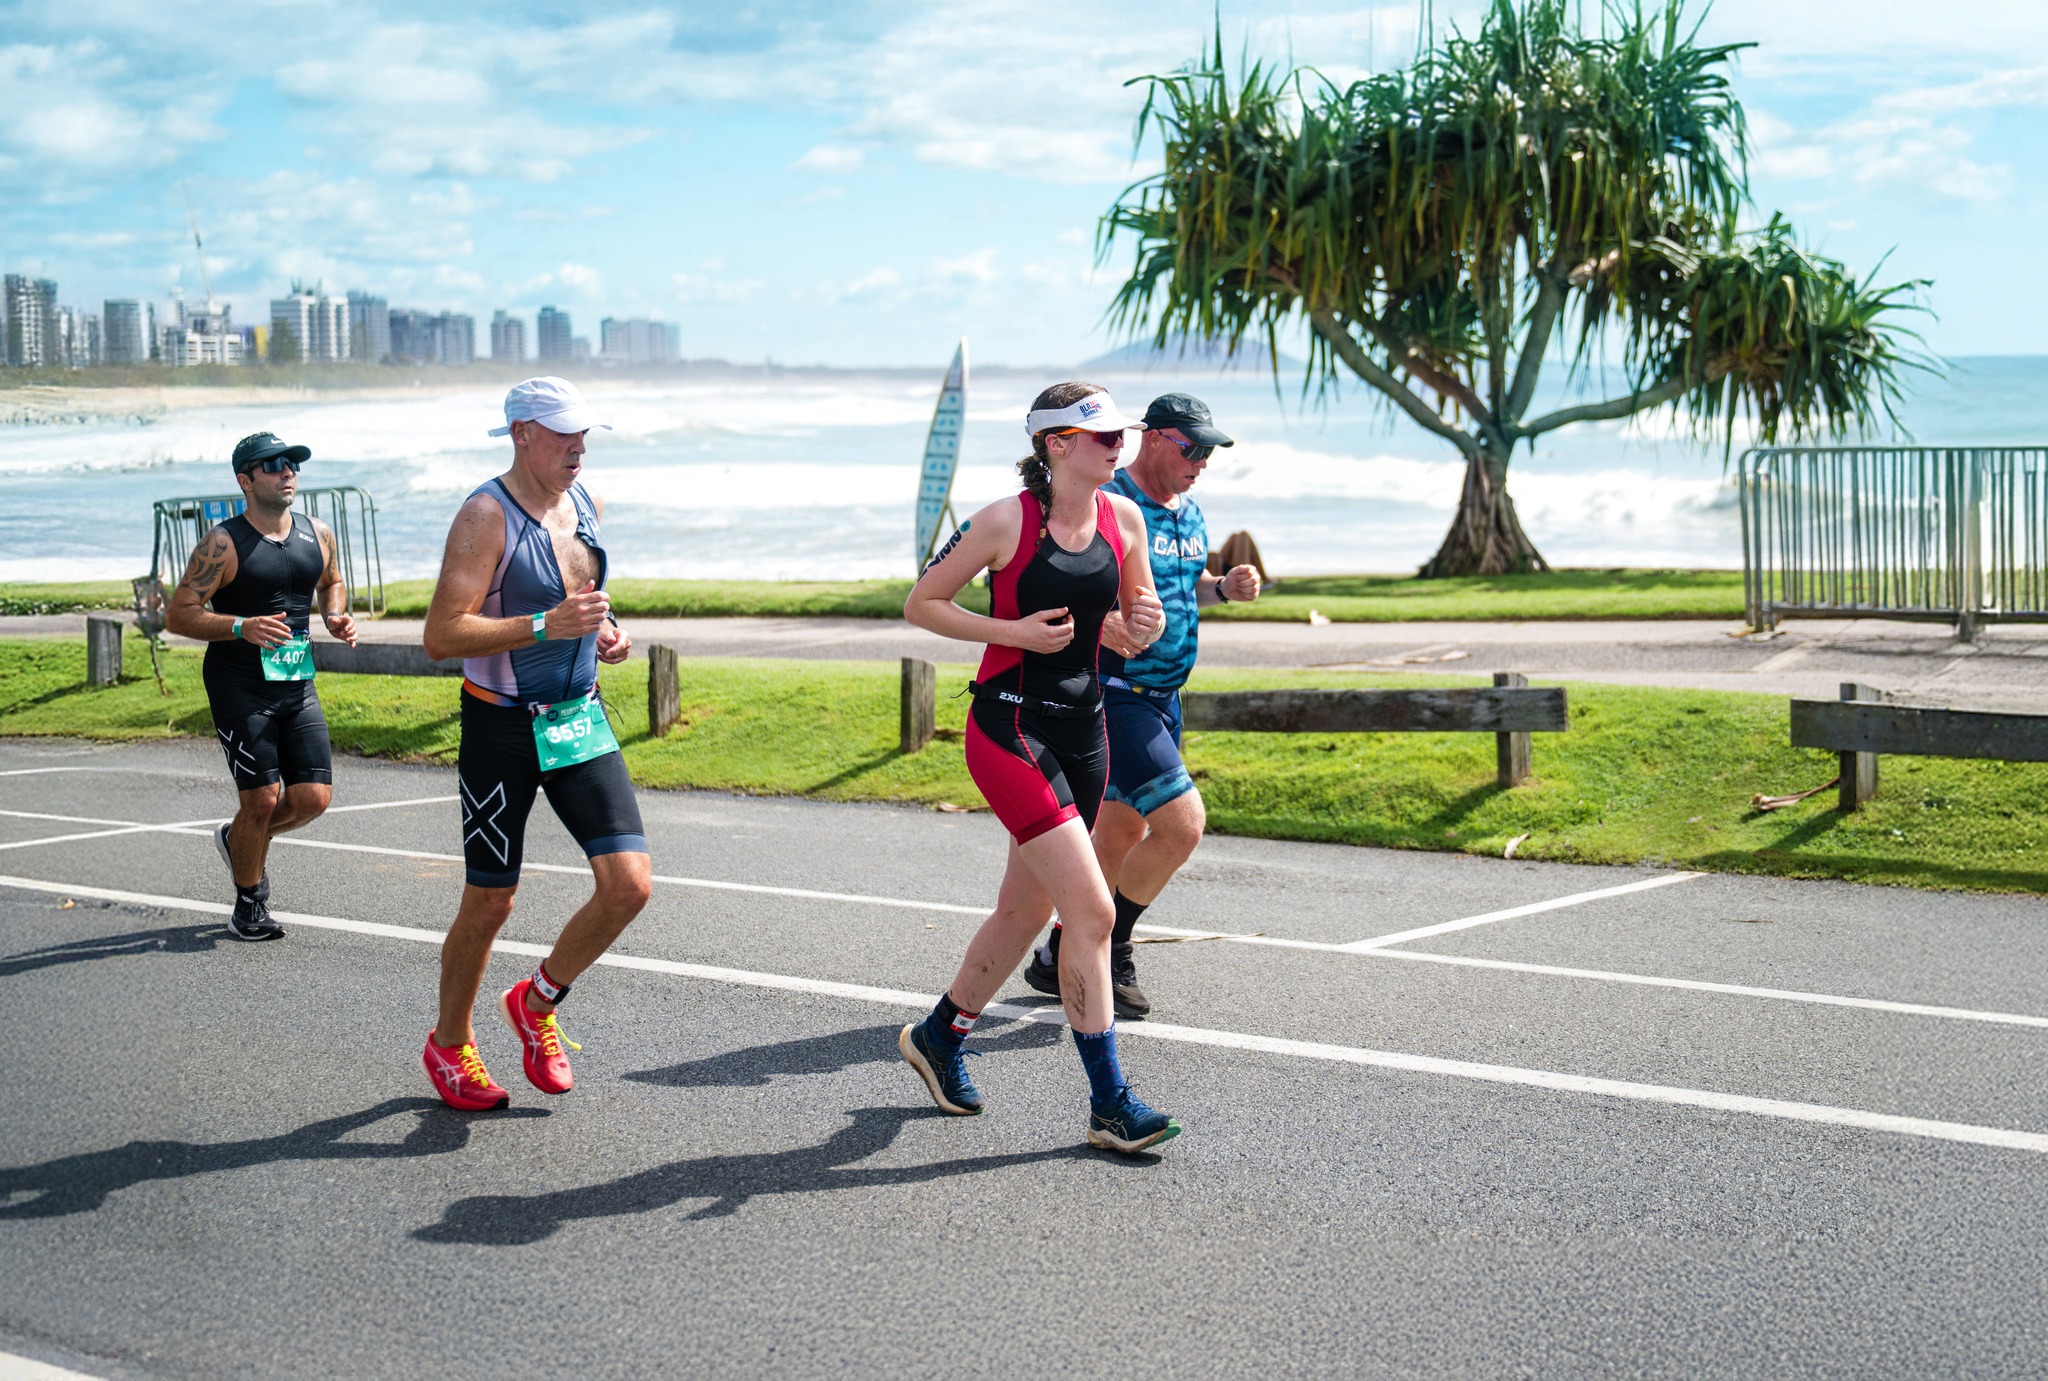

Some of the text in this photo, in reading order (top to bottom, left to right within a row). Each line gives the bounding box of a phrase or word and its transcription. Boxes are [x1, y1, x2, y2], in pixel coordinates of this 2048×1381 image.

[271, 650, 306, 665] 4407
[999, 691, 1024, 704] 2XU
[546, 717, 592, 744] 3557
